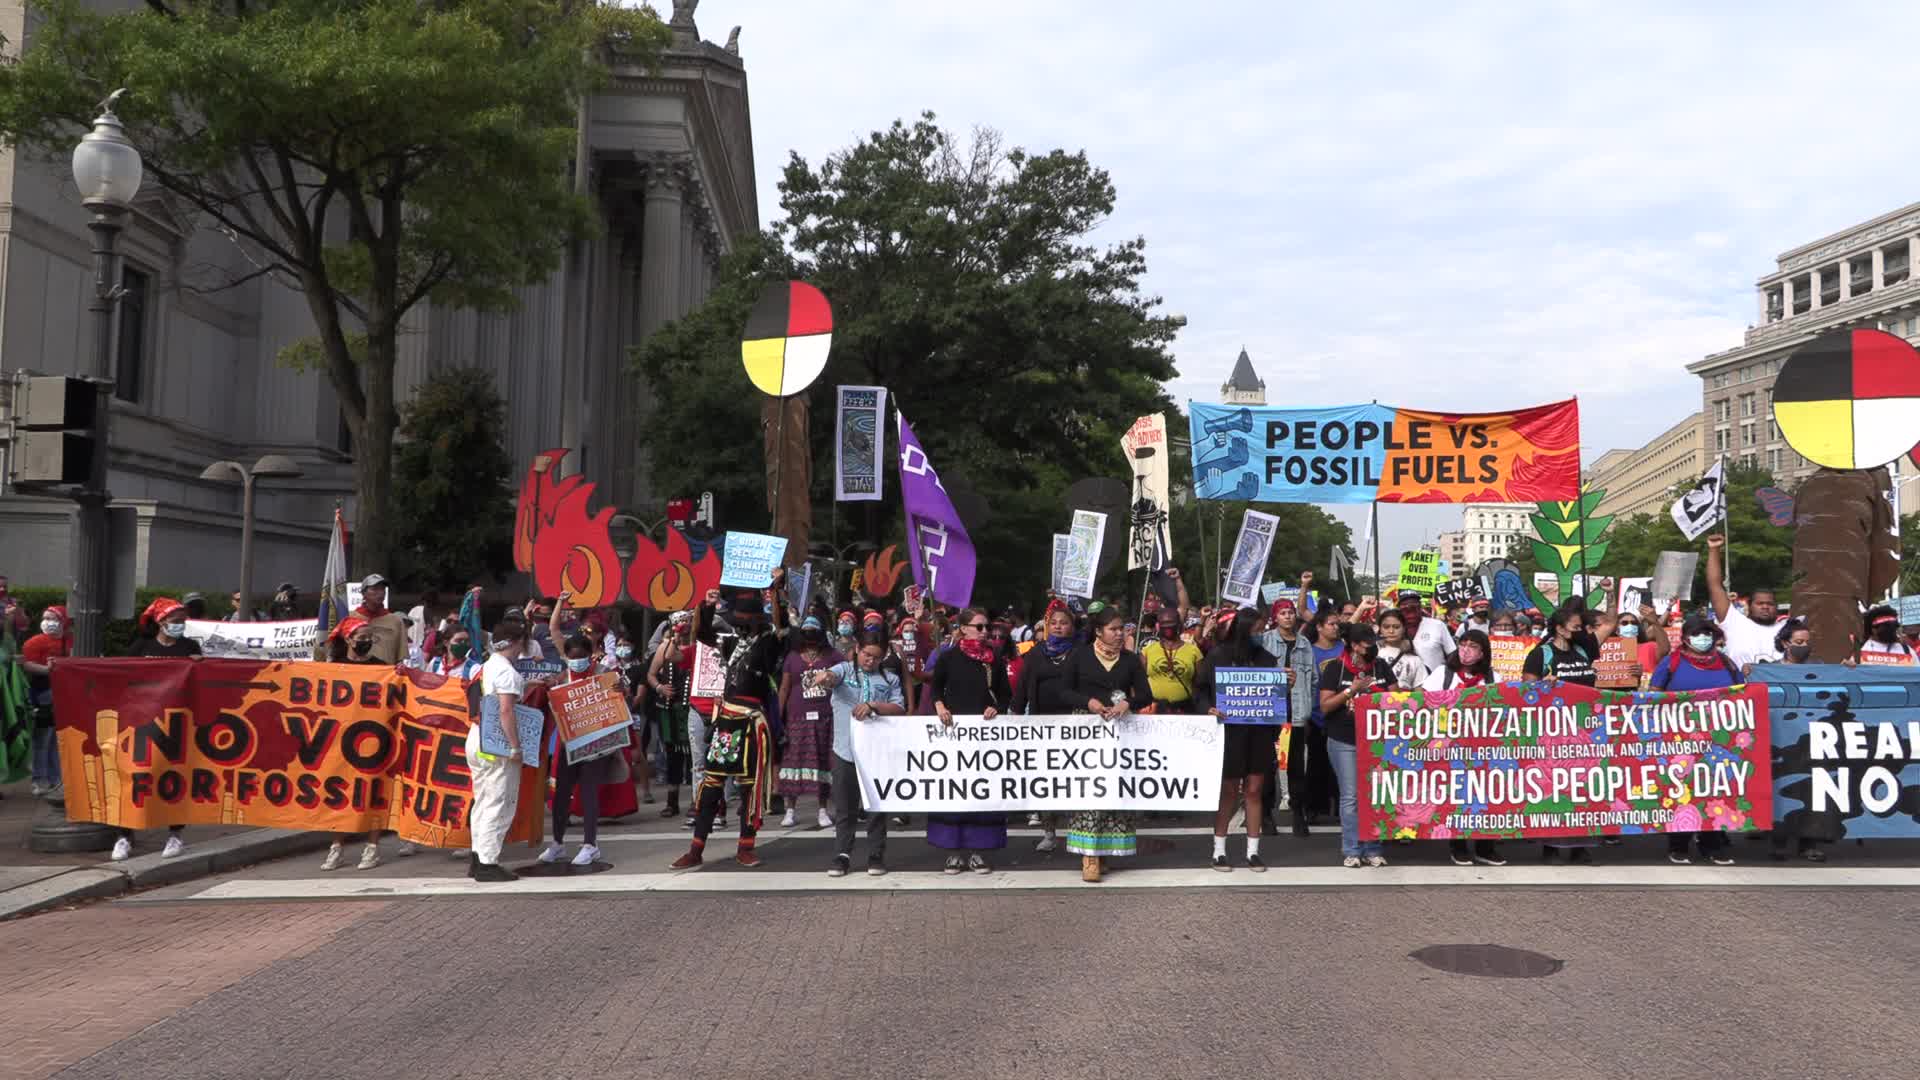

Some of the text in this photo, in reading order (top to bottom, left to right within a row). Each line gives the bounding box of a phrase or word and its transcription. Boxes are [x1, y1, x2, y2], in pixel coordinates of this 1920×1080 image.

[1265, 421, 1498, 450] PEOPLE VS.
[1265, 454, 1498, 486] FOSSIL FUELS
[730, 560, 768, 571] CLIMATE
[1406, 551, 1433, 563] PLANET
[1409, 563, 1428, 574] OVER
[1401, 575, 1432, 586] PROFITS
[1437, 579, 1473, 594] END
[1438, 585, 1484, 604] LINE 3
[274, 627, 297, 638] THE
[1490, 641, 1525, 650] BIDEN
[1601, 642, 1621, 650] DEN
[1233, 673, 1267, 681] BIDEN
[290, 677, 409, 711] BIDEN
[568, 681, 601, 698] BIDEN
[1225, 686, 1273, 697] REJECT
[563, 690, 609, 712] REJECT
[571, 711, 617, 729] PROJECTS
[1226, 709, 1274, 717] PROJECTS
[1366, 705, 1579, 740] DECOLONIZATION
[1604, 699, 1755, 736] EXTINCTION
[957, 725, 1120, 742] PRESIDENT BIDEN,
[132, 712, 256, 768] NO
[285, 717, 473, 791] VOTE
[906, 748, 1168, 772] NO MORE EXCUSES:
[1407, 748, 1440, 762] BUILD
[1443, 746, 1476, 761] UNTIL
[1620, 743, 1643, 757] AND
[1645, 740, 1713, 756] #LANDBACK
[131, 768, 220, 808] FOR
[237, 771, 389, 813] FOSSIL
[873, 776, 1199, 801] VOTING RIGHTS NOW!
[1371, 761, 1750, 805] INDIGENOUS PEOPLE'S DAY
[1445, 809, 1675, 830] #THEREDDEAL WWW.THEREDNATION.ORG
